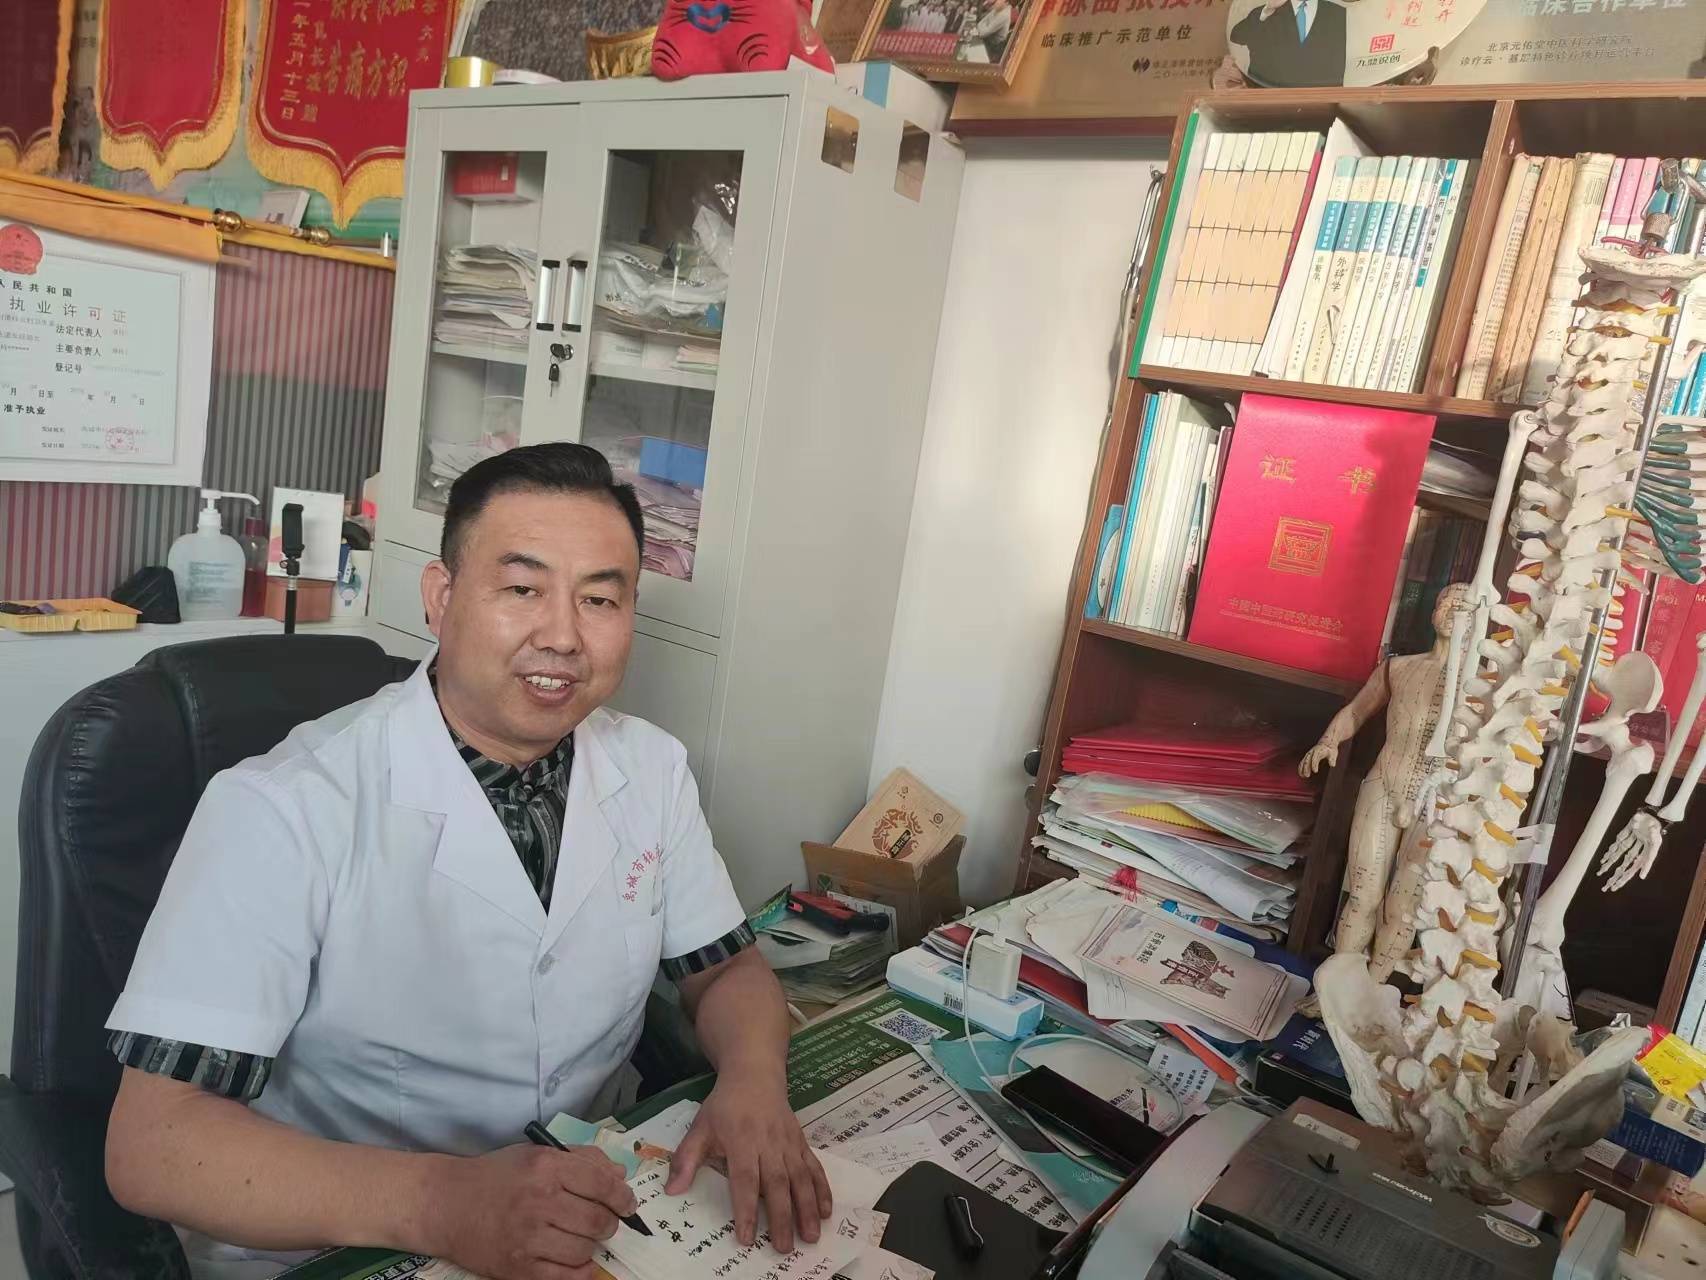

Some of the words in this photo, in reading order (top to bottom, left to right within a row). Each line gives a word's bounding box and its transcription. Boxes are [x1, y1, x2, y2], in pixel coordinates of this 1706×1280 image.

[1041, 24, 1193, 48] 临床推广示范单位
[56, 325, 102, 338] 法定代表人
[56, 344, 102, 357] 主要负责人
